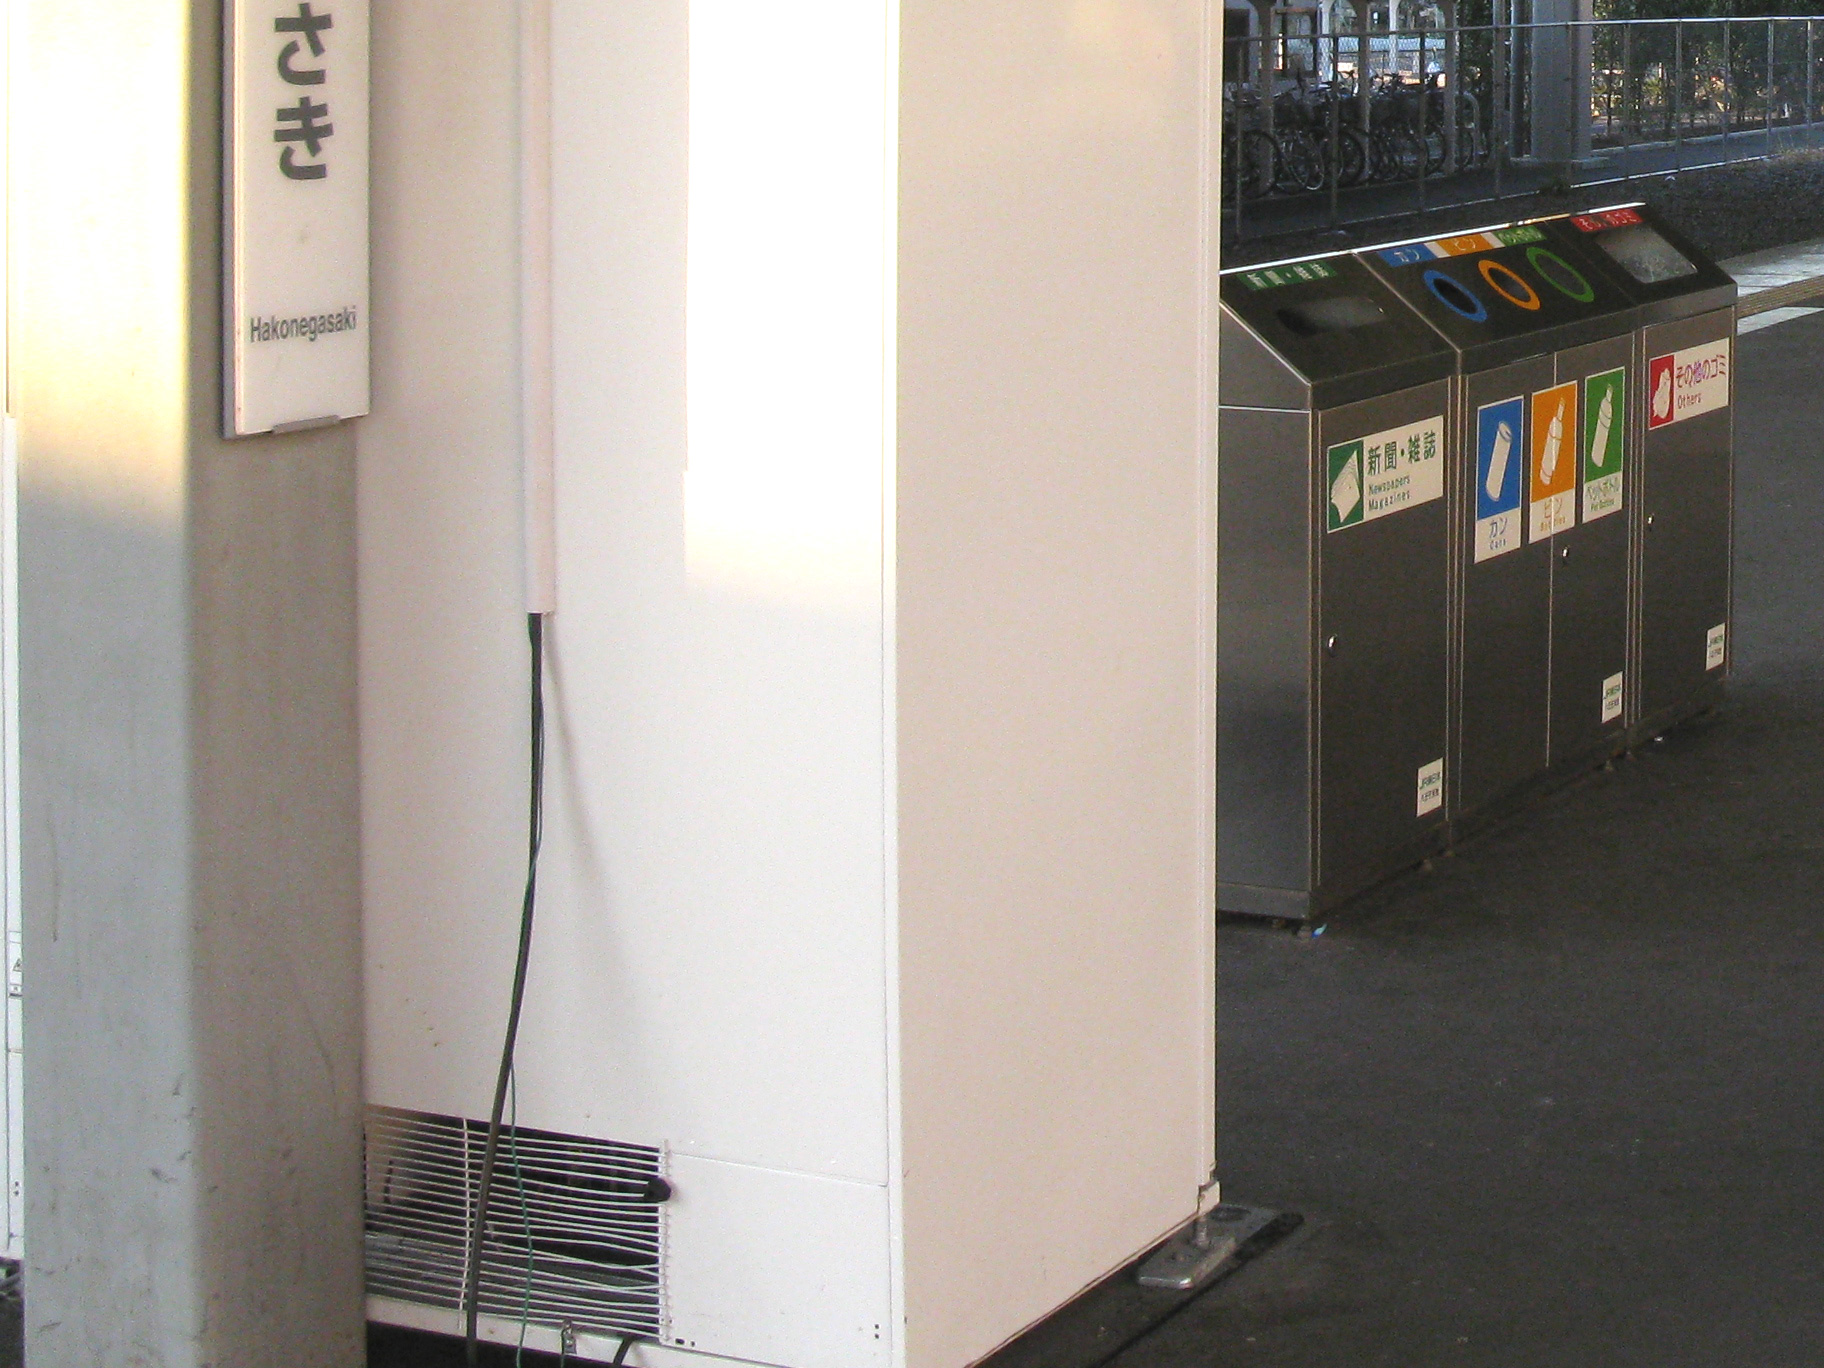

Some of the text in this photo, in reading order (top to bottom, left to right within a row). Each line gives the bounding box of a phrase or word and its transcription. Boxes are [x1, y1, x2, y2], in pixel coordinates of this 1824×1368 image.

[250, 305, 357, 343] Hakonegasaki
[1675, 353, 1727, 388] その他のゴミ
[1677, 392, 1702, 409] Others
[1368, 430, 1436, 476] 新聞・雑誌
[1368, 474, 1411, 495] Newspapers
[1368, 491, 1410, 511] Magazines
[1489, 517, 1508, 539] カン
